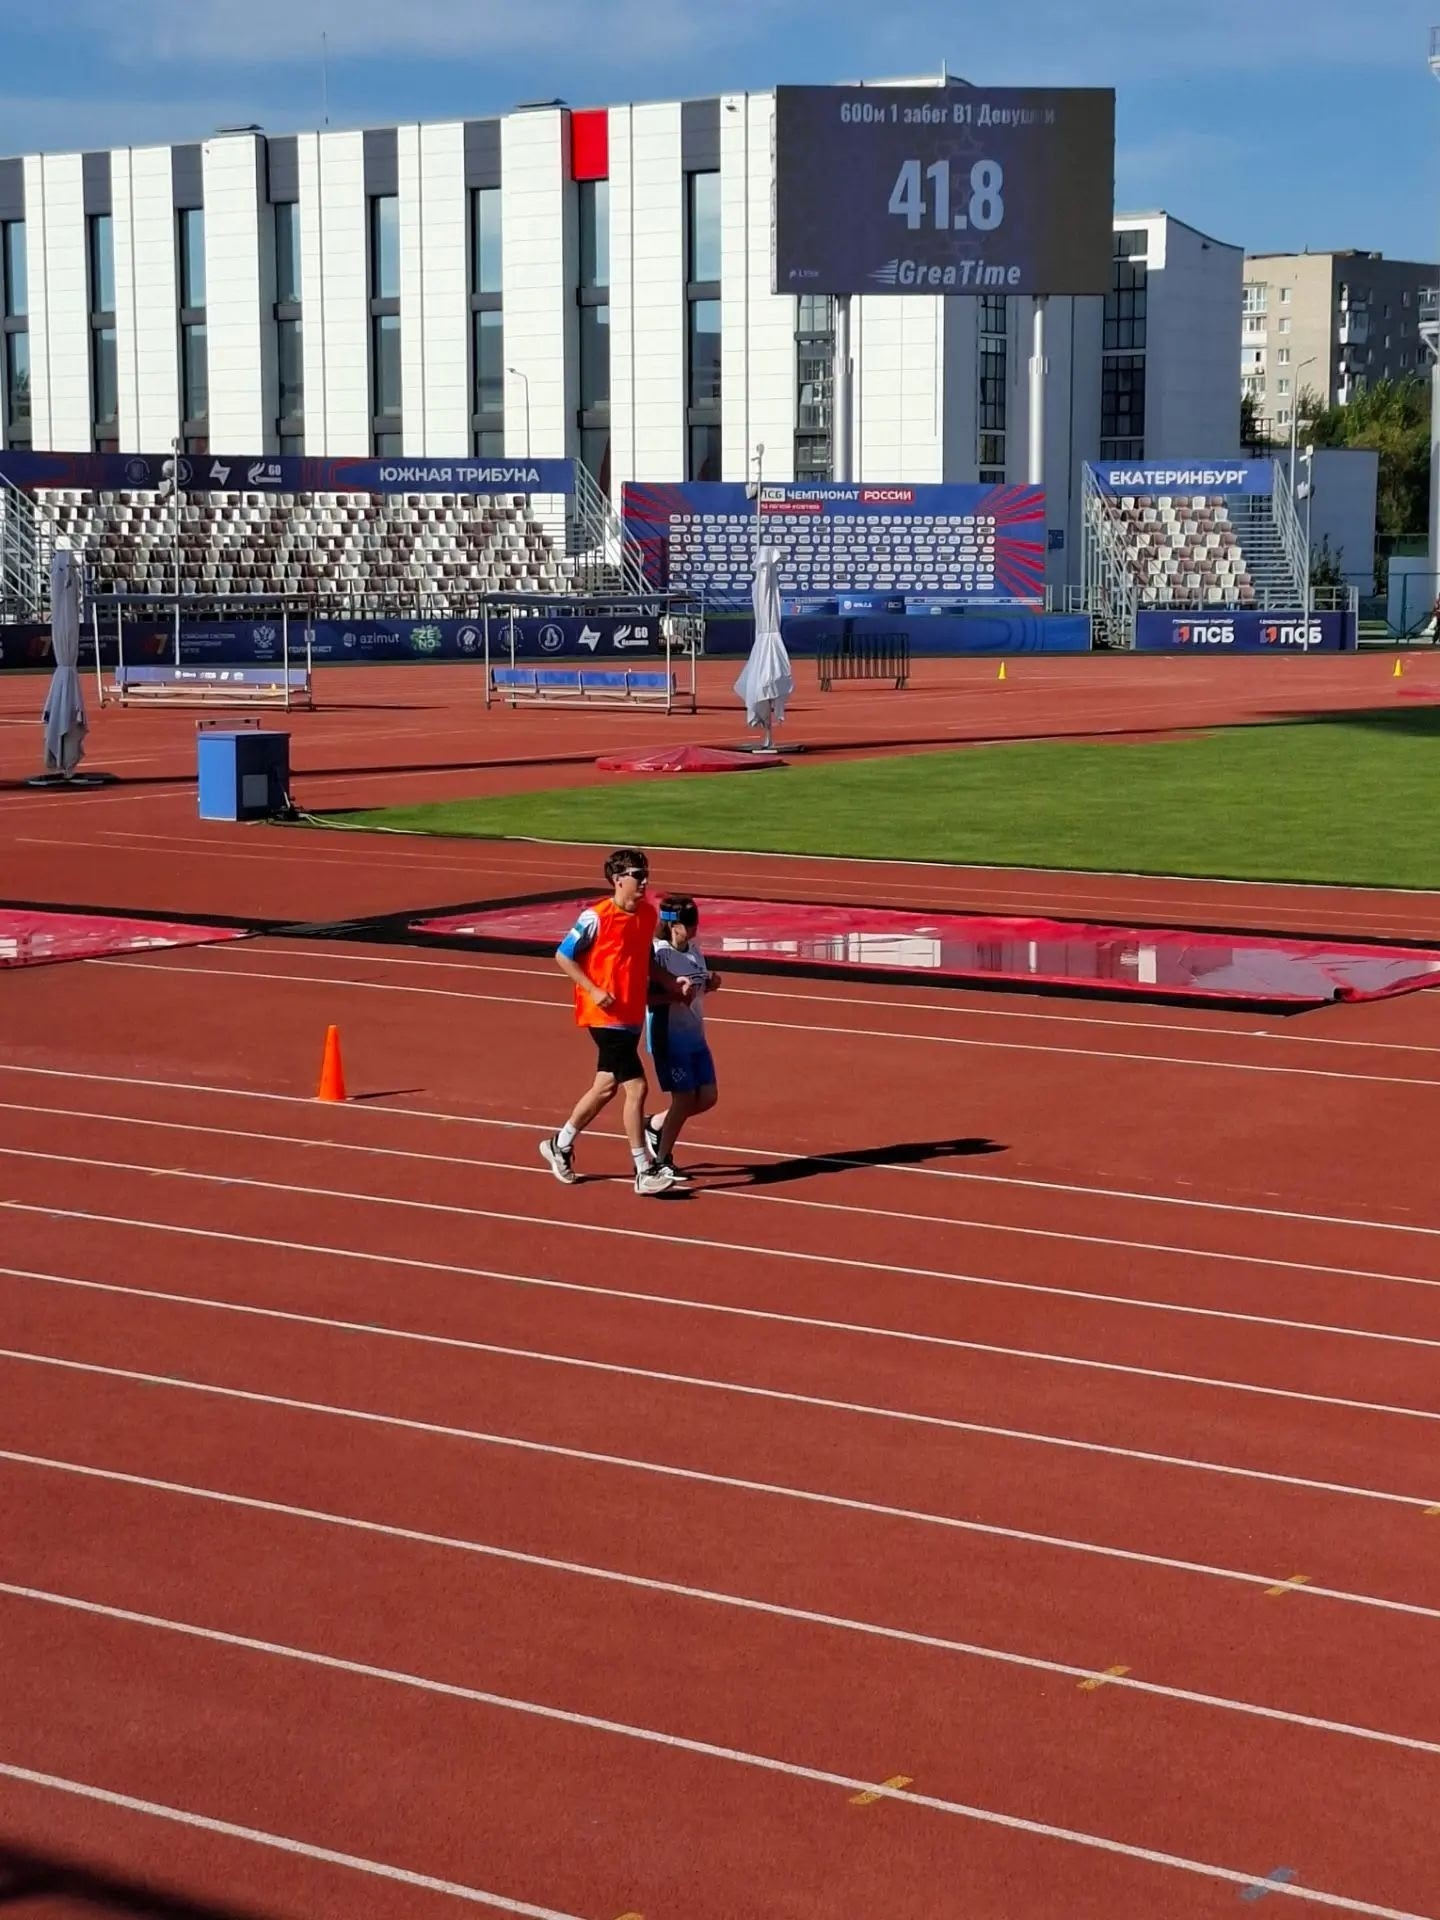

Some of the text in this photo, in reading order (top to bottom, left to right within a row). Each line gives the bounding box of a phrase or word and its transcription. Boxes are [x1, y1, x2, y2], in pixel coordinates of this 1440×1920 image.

[840, 103, 885, 123] 600м
[890, 104, 898, 123] 1
[903, 104, 948, 124] забег
[887, 159, 1004, 231] 41.8
[898, 259, 1021, 286] GreaTime
[379, 466, 540, 482] ЮЖНАЯ ТРИБУНА
[1109, 469, 1249, 486] ЕКАТЕРИНБУРГ
[786, 490, 860, 501] ЧЕМПИОНАТ
[864, 491, 912, 501] РОССИИ
[360, 632, 400, 644] azimut
[1193, 626, 1235, 643] ПСБ
[1280, 626, 1323, 644] ПСБ
